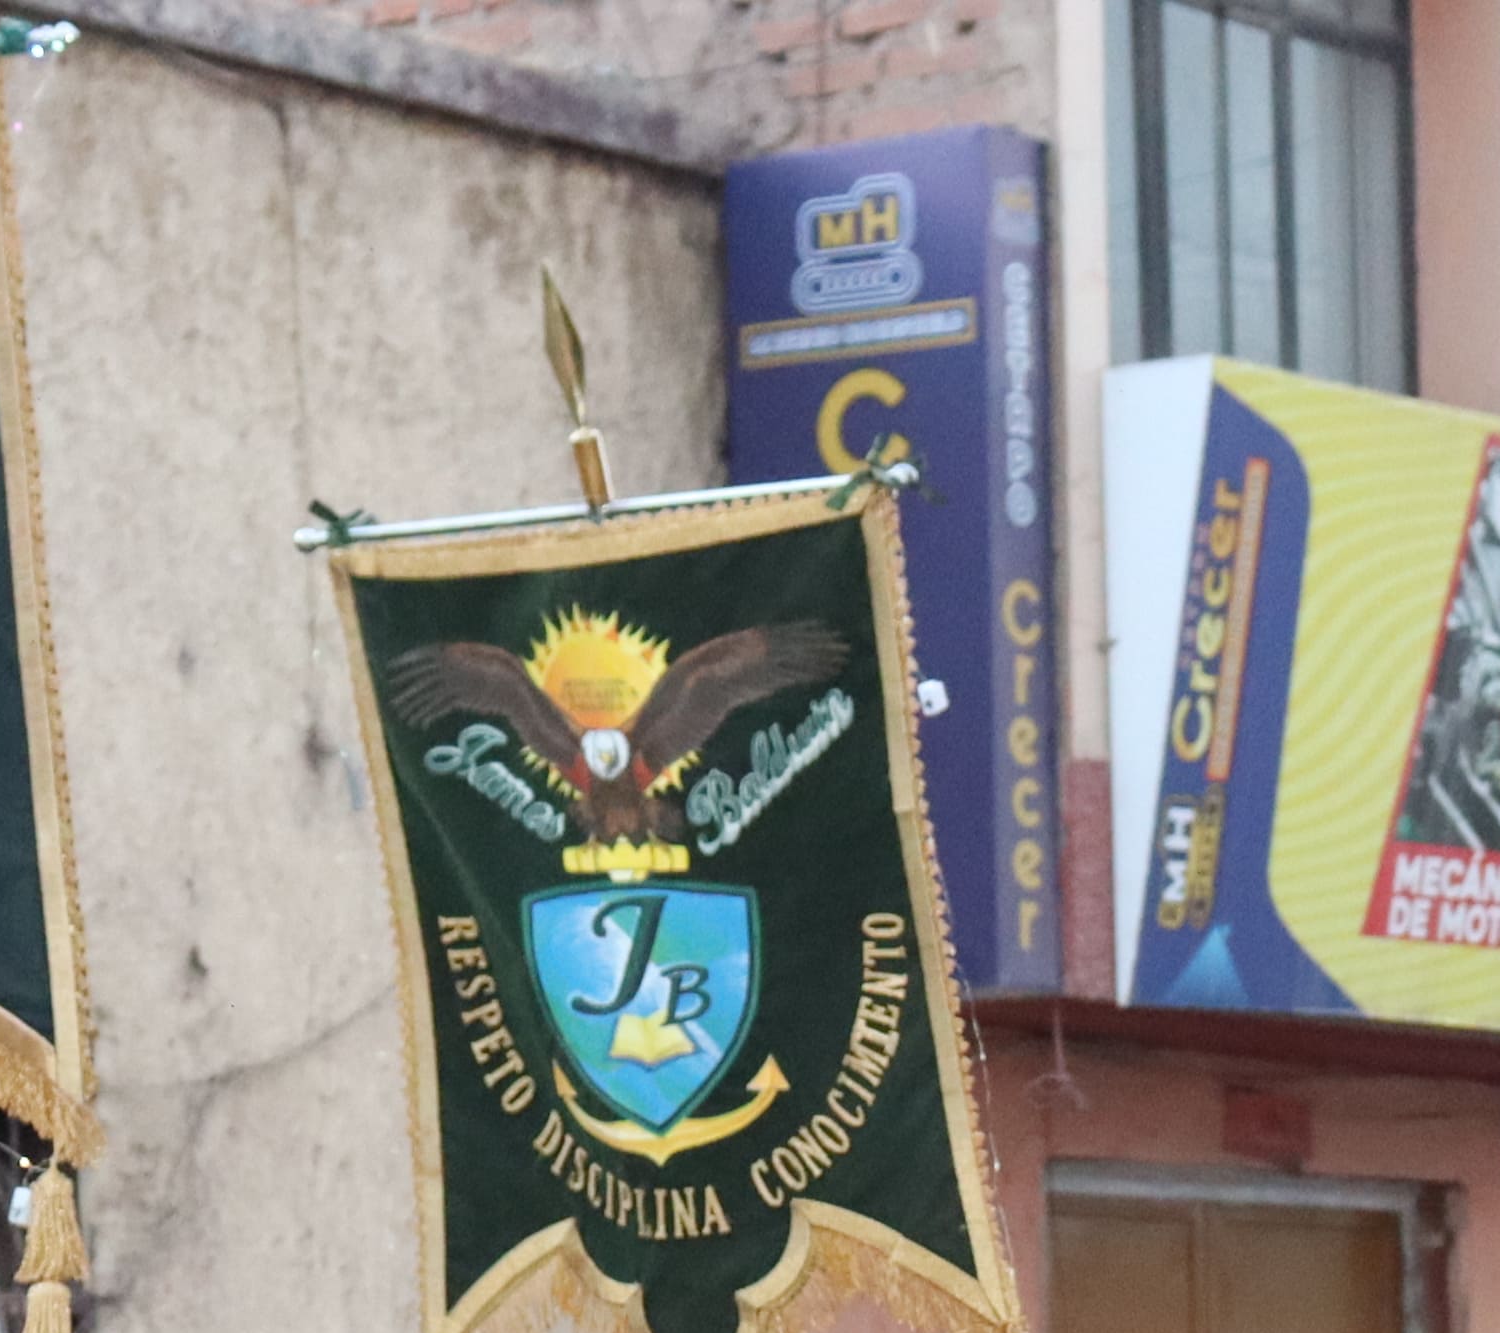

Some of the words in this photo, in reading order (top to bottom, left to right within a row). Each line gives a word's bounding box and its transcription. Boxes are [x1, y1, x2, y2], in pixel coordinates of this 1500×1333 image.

[817, 195, 898, 249] MH
[1171, 478, 1242, 763] Crecer
[423, 721, 569, 842] James
[686, 686, 857, 856] Baldwin
[1001, 579, 1044, 953] Crecer
[1161, 804, 1197, 903] MH
[1386, 895, 1429, 938] DE
[438, 914, 538, 1117] RESPETO
[533, 1109, 733, 1241] DISCIPLINA
[748, 911, 906, 1209] CONOCIMIENTO
